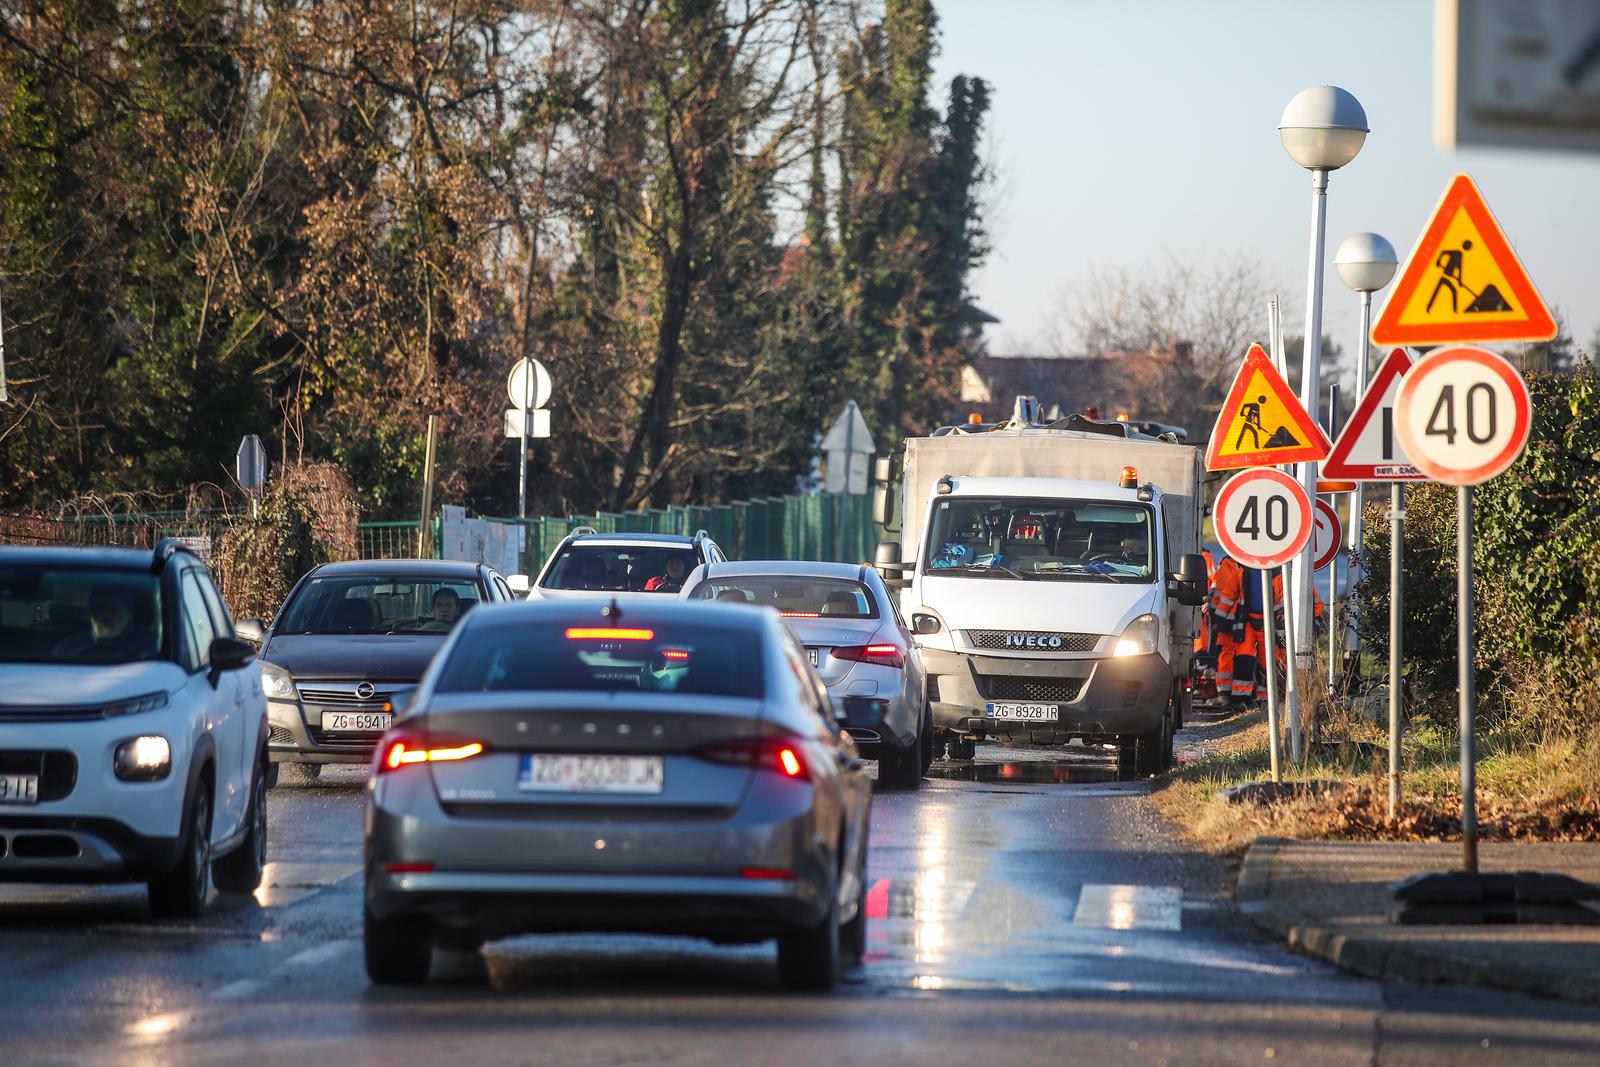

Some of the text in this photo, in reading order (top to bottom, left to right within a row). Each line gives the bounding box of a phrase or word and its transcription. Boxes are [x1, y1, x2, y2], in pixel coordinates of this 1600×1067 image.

[1426, 382, 1497, 445] 40
[1235, 495, 1288, 541] 40
[1006, 636, 1061, 647] IVECO
[995, 705, 1008, 717] ZG
[333, 715, 348, 728] ZG
